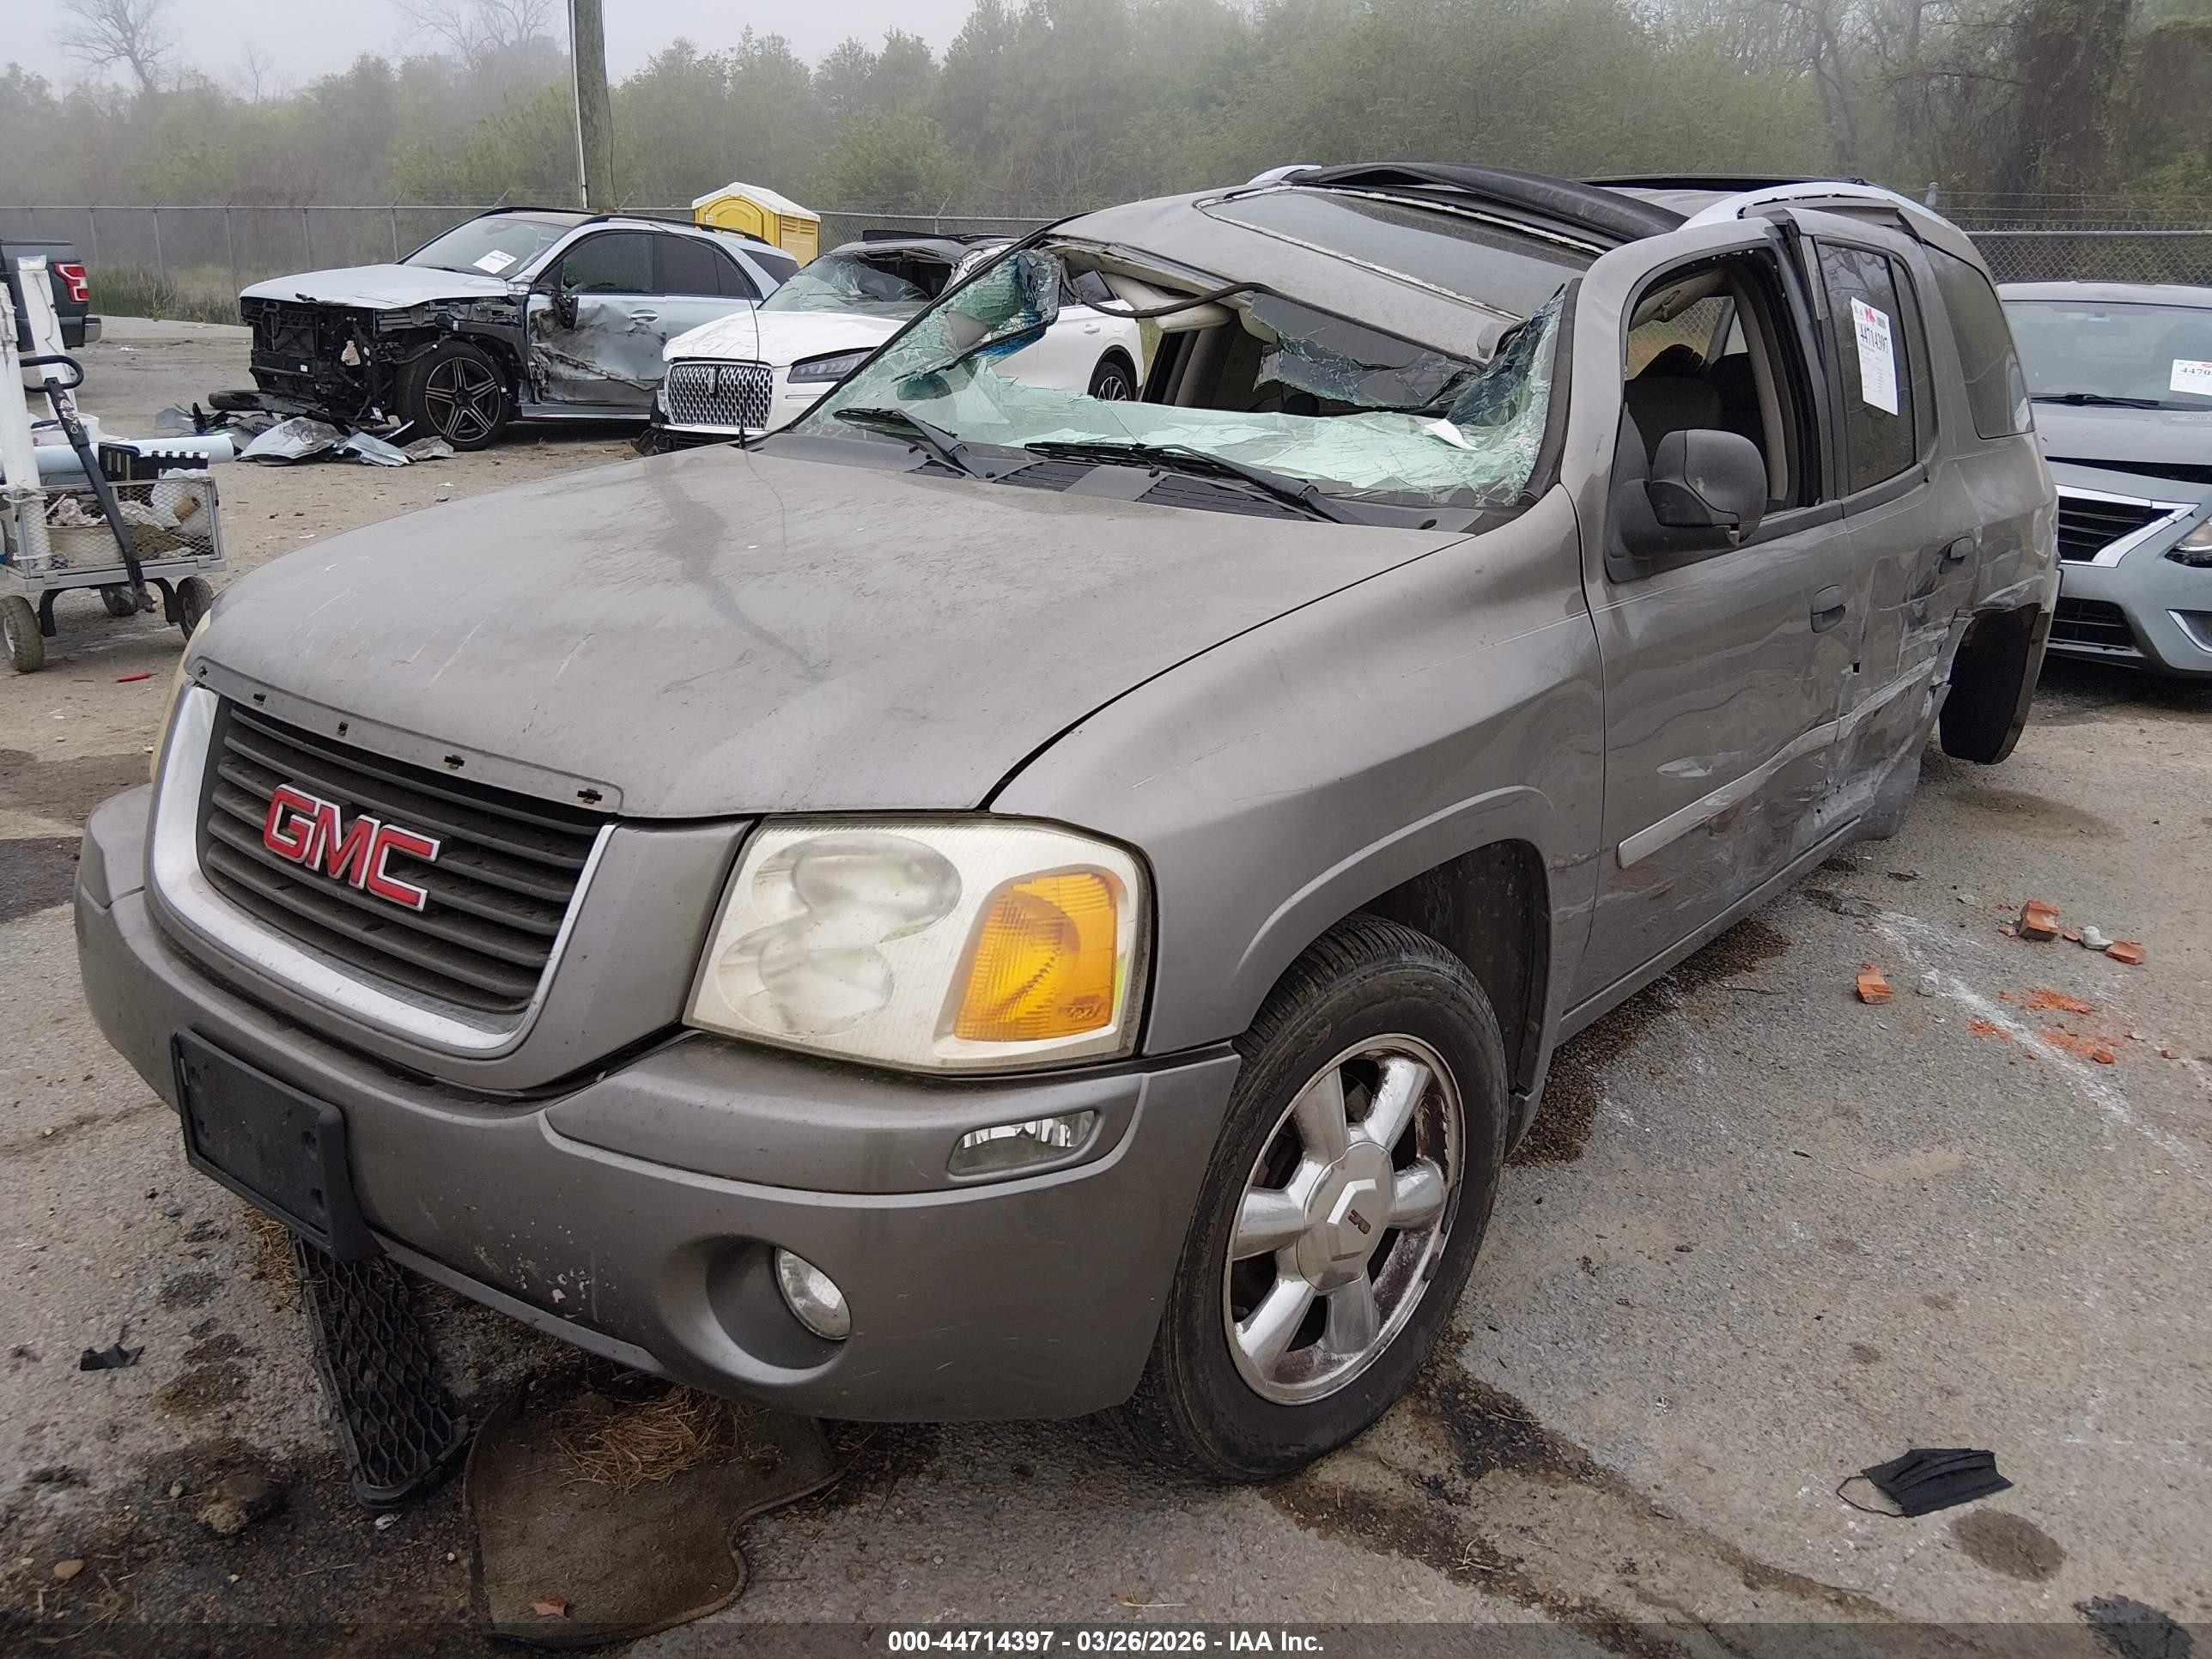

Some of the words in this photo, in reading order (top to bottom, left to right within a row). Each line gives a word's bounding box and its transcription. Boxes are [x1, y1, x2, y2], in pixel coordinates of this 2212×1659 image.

[1860, 324, 1889, 354] 44714397
[2180, 367, 2212, 376] 4470
[263, 783, 441, 912] GMC
